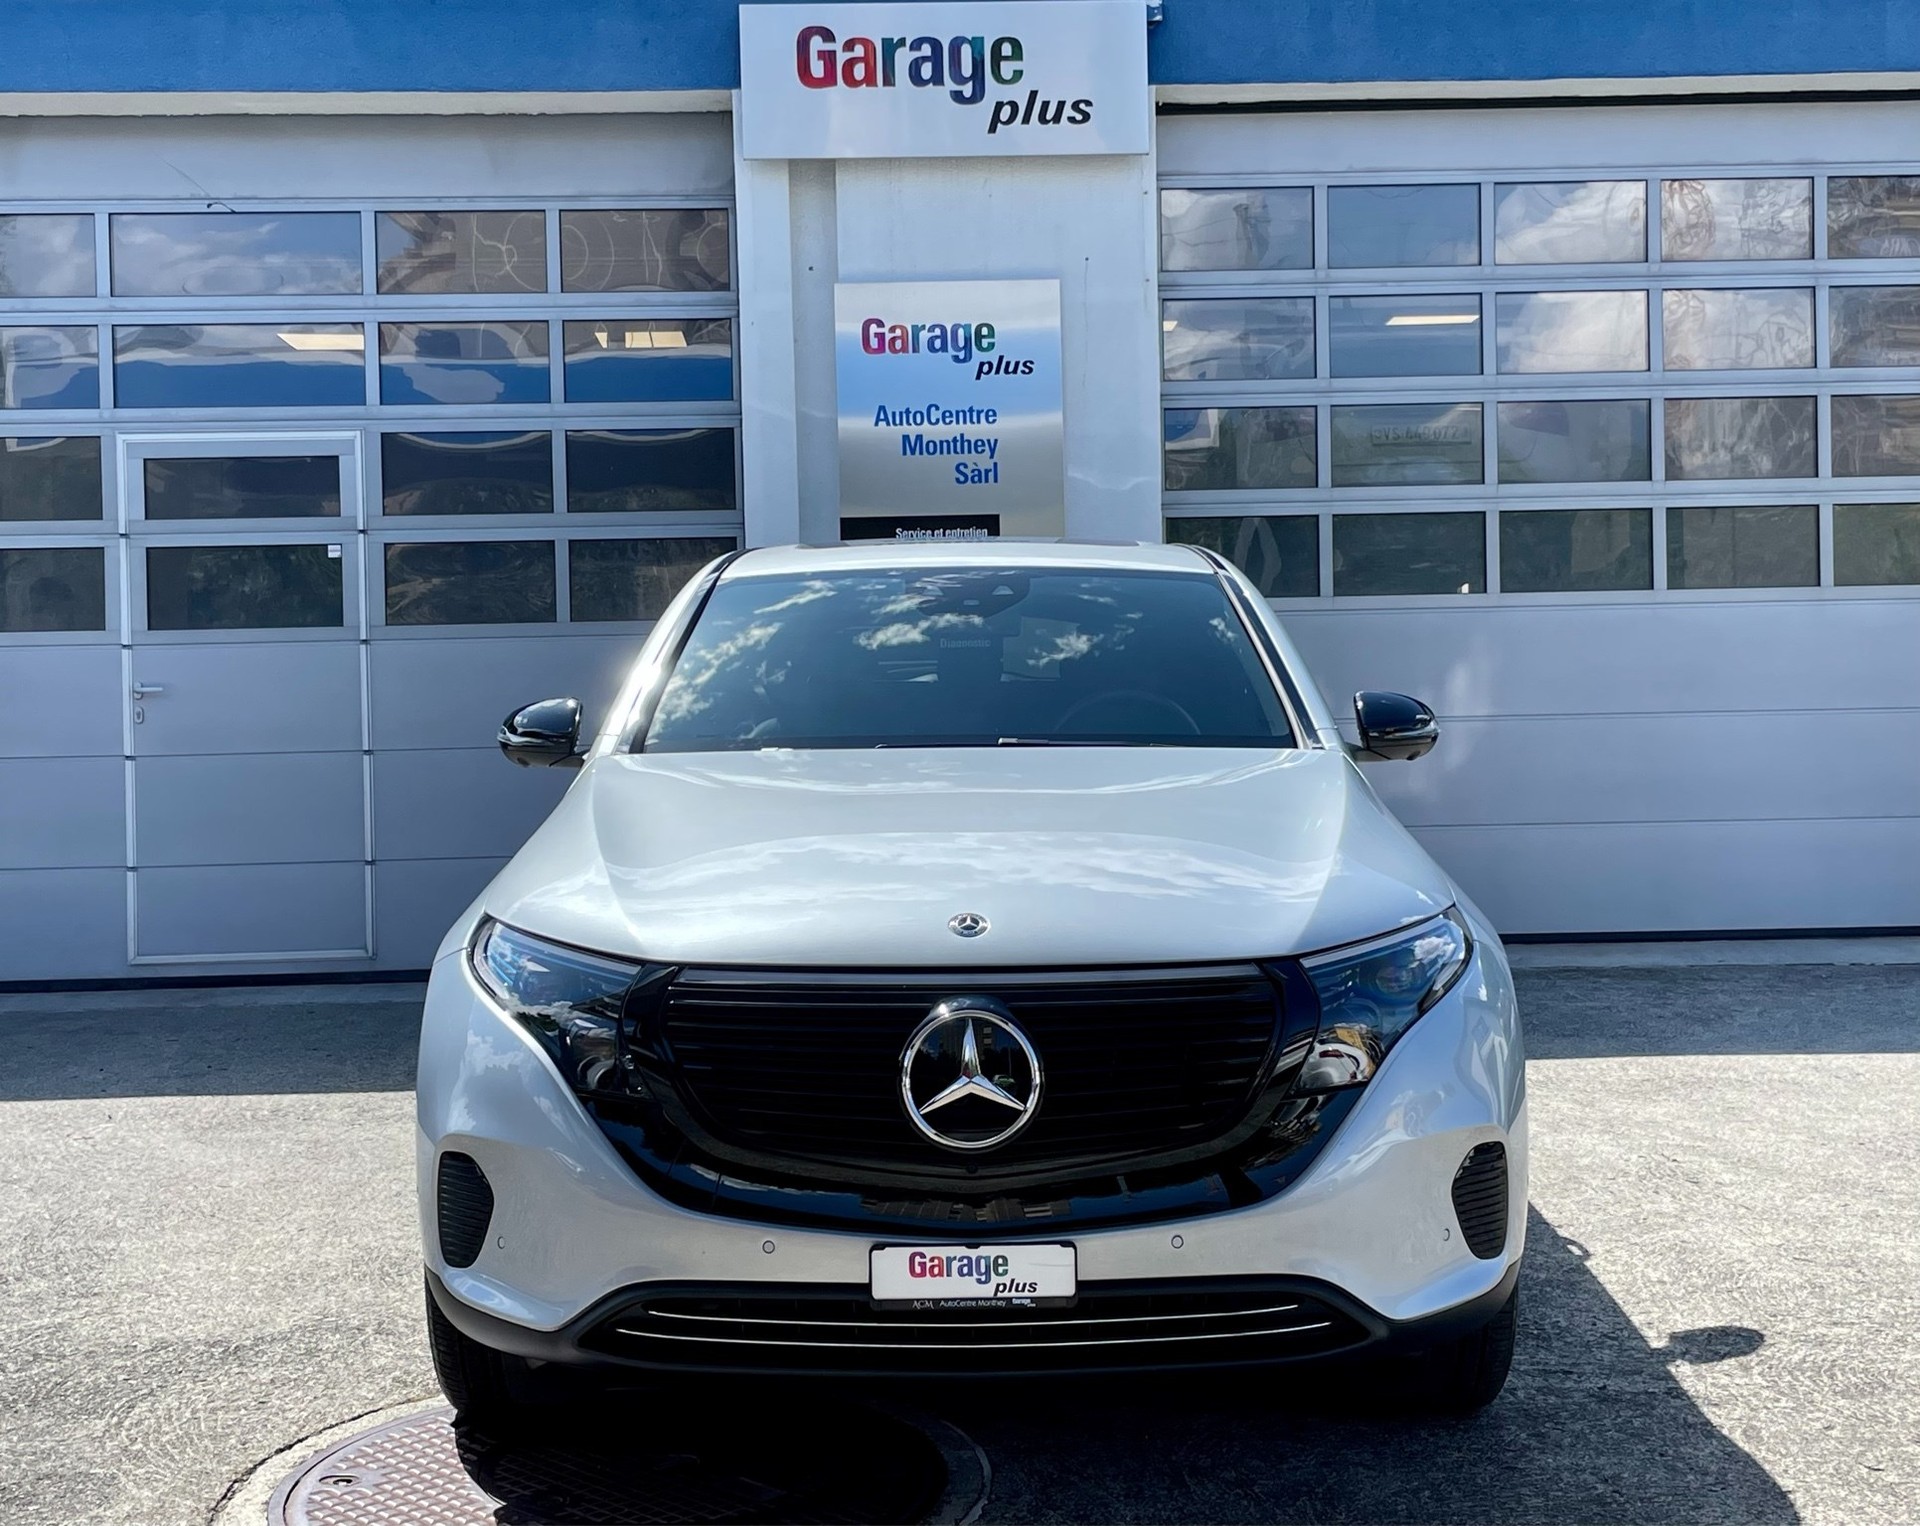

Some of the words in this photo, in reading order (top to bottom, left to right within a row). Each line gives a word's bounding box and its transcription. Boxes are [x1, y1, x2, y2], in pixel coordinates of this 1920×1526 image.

[796, 25, 1024, 105] Garage
[987, 90, 1094, 135] plus
[861, 318, 996, 364] Garage
[975, 355, 1035, 380] plus
[874, 403, 998, 427] AutoCentre
[901, 433, 999, 459] Monthey
[954, 461, 999, 485] Sàrl
[895, 527, 932, 540] Service
[945, 526, 988, 539] entretien
[908, 1251, 1009, 1285] Garage
[993, 1278, 1038, 1297] plus
[939, 1300, 977, 1308] AutoCentre
[978, 1299, 1007, 1308] Monthey
